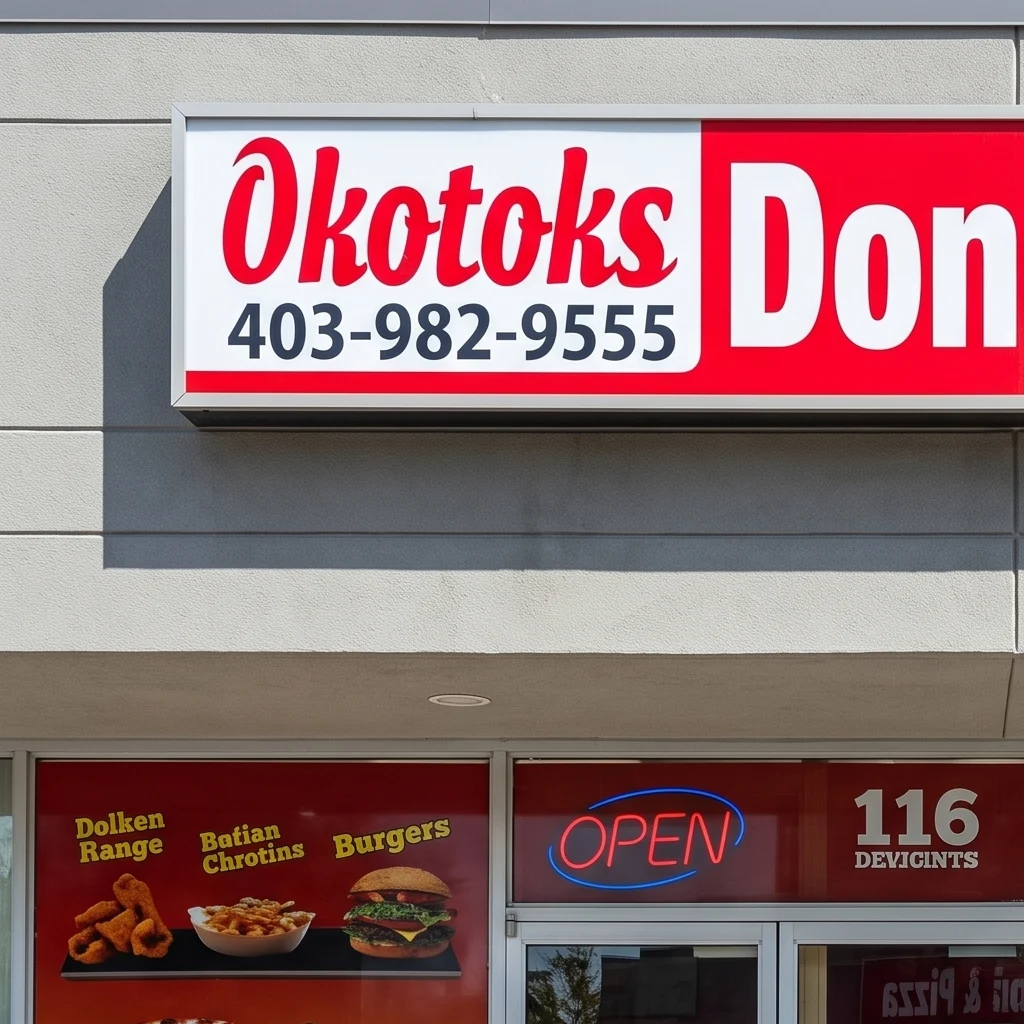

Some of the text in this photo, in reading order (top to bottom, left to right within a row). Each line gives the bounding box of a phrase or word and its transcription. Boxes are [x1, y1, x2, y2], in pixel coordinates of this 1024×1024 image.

[223, 138, 677, 287] Okotoks
[228, 303, 676, 361] 403-982-9555
[75, 811, 165, 840] Dolken
[333, 818, 450, 860] Burgers
[560, 811, 730, 869] OPEN
[855, 788, 979, 846] 116
[79, 835, 163, 864] Range
[203, 842, 305, 875] Chrotins
